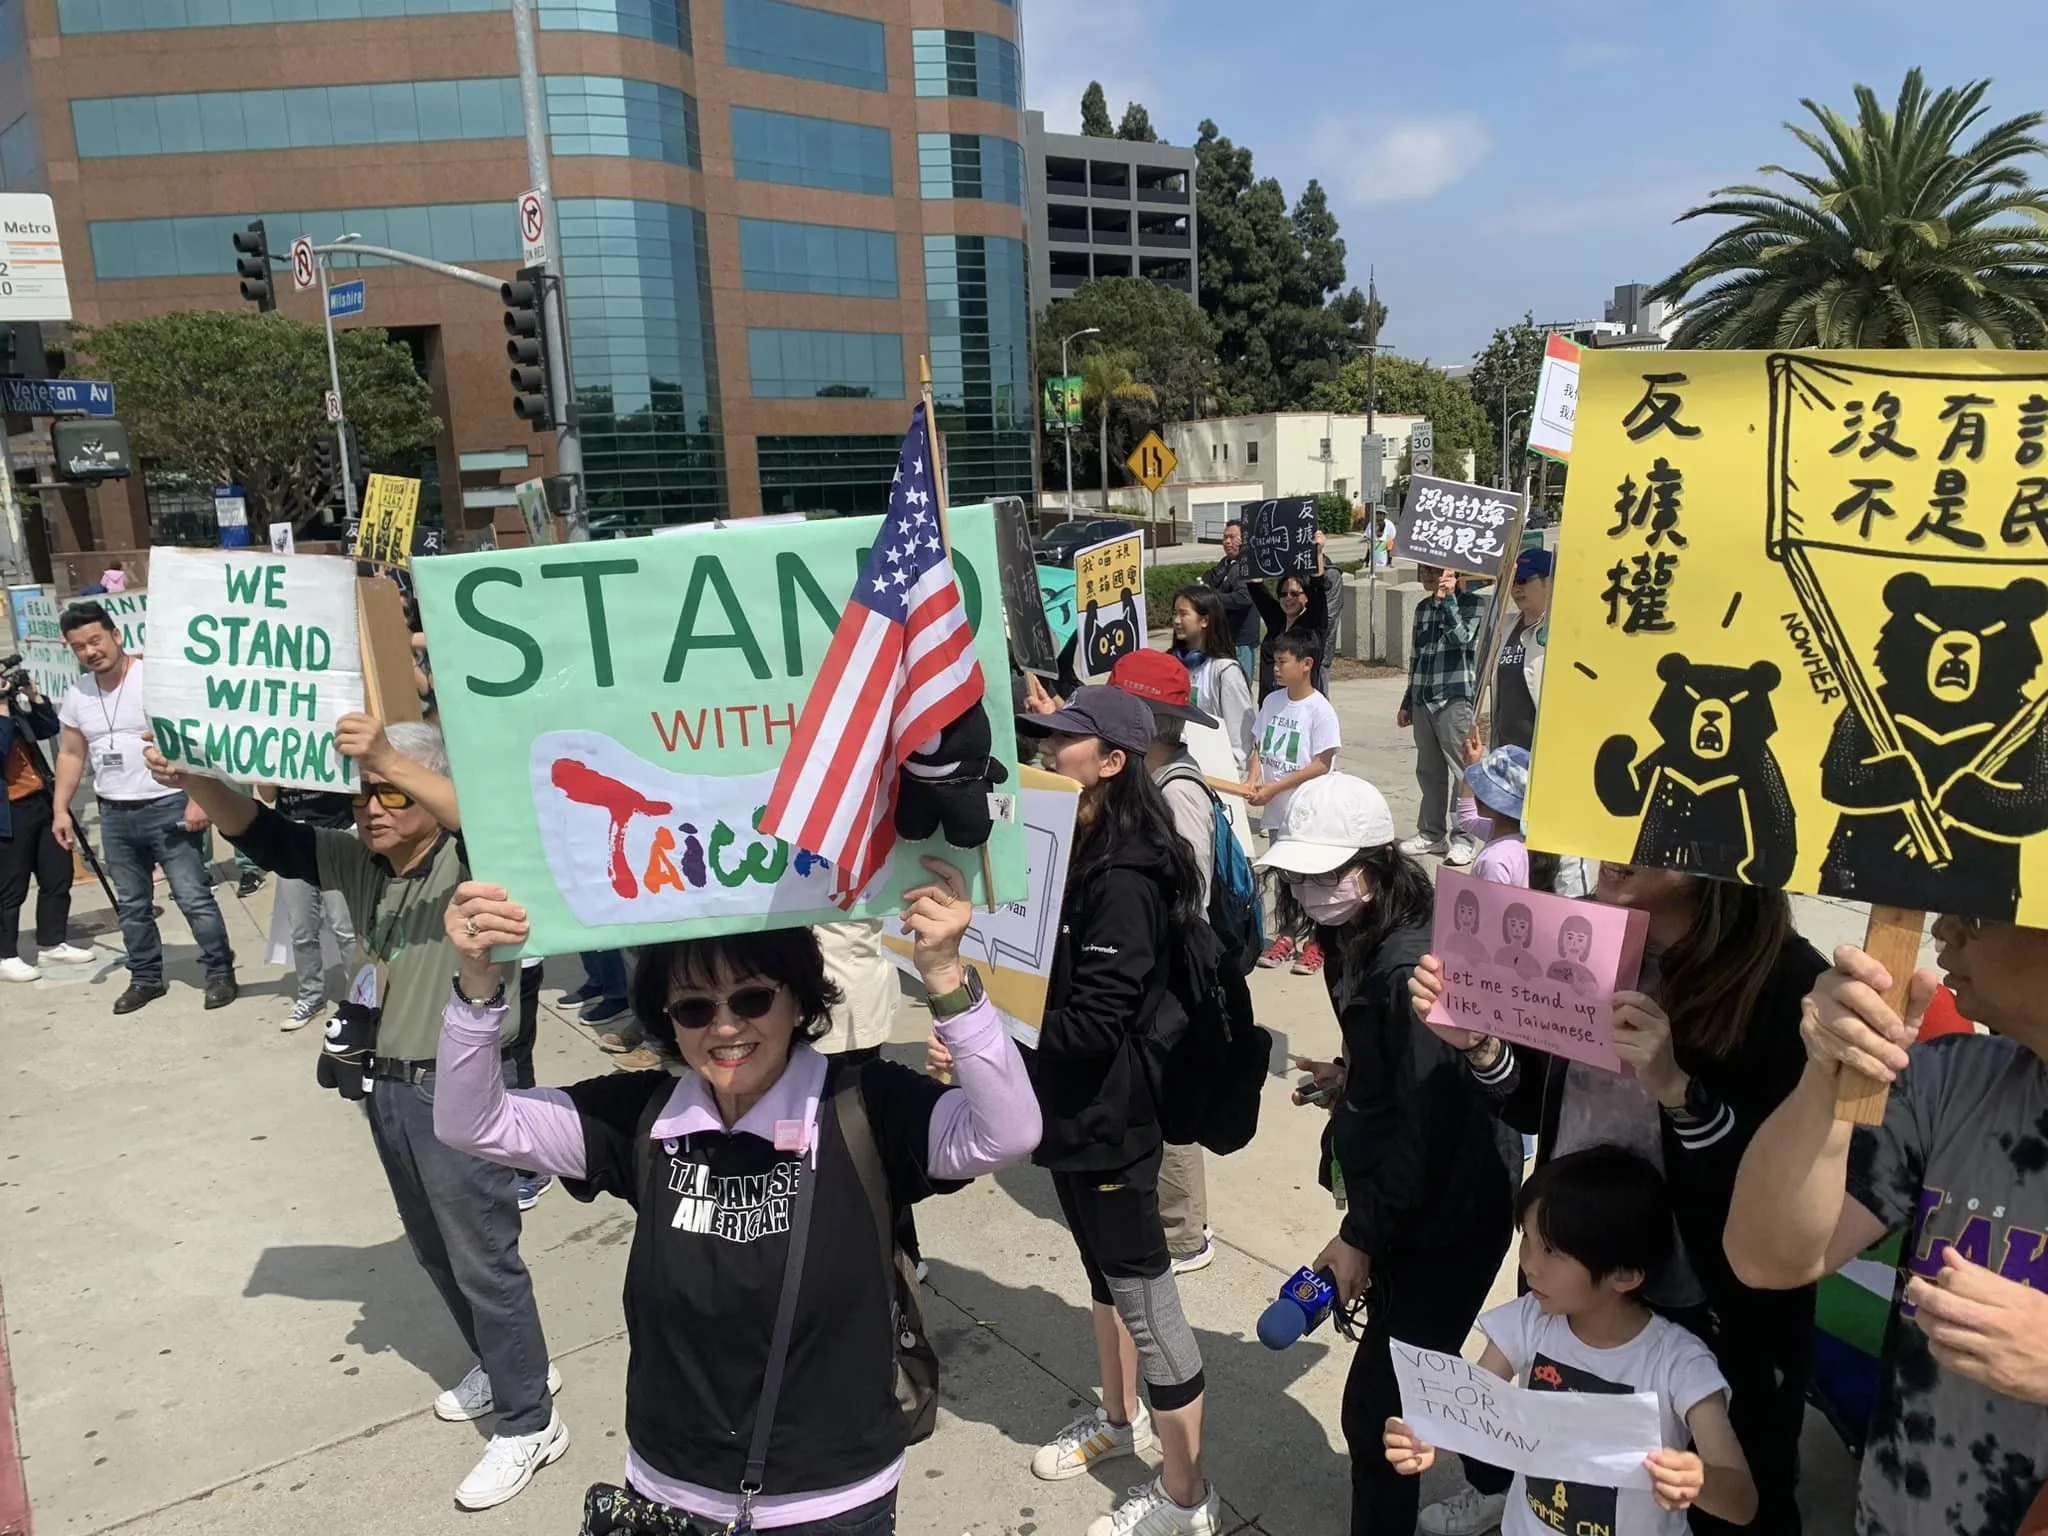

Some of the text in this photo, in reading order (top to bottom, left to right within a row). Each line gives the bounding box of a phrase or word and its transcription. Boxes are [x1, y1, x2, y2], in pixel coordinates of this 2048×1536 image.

[4, 221, 51, 234] Metro
[9, 381, 108, 402] Veteran Av
[1414, 437, 1431, 449] 30
[1600, 372, 1702, 634] 反擴權
[225, 564, 287, 608] WE
[184, 614, 331, 671] STAND
[1780, 613, 1841, 704] NOWHER
[206, 675, 316, 721] WITH
[651, 703, 797, 752] WITH
[1272, 715, 1298, 730] TEAM
[1442, 961, 1596, 1025] Let me stand up
[1446, 992, 1481, 1015] like
[1493, 1009, 1504, 1022] a
[1512, 1007, 1604, 1046] Taiwanese.
[671, 1197, 790, 1243] AMERICAN
[1945, 1191, 2006, 1218] LOS
[1302, 1270, 1332, 1293] NTD
[1396, 1346, 1492, 1392] VOTE
[1417, 1377, 1500, 1418] FOR
[1418, 1398, 1541, 1453] TAIWAN
[1576, 1520, 1610, 1536] ON
